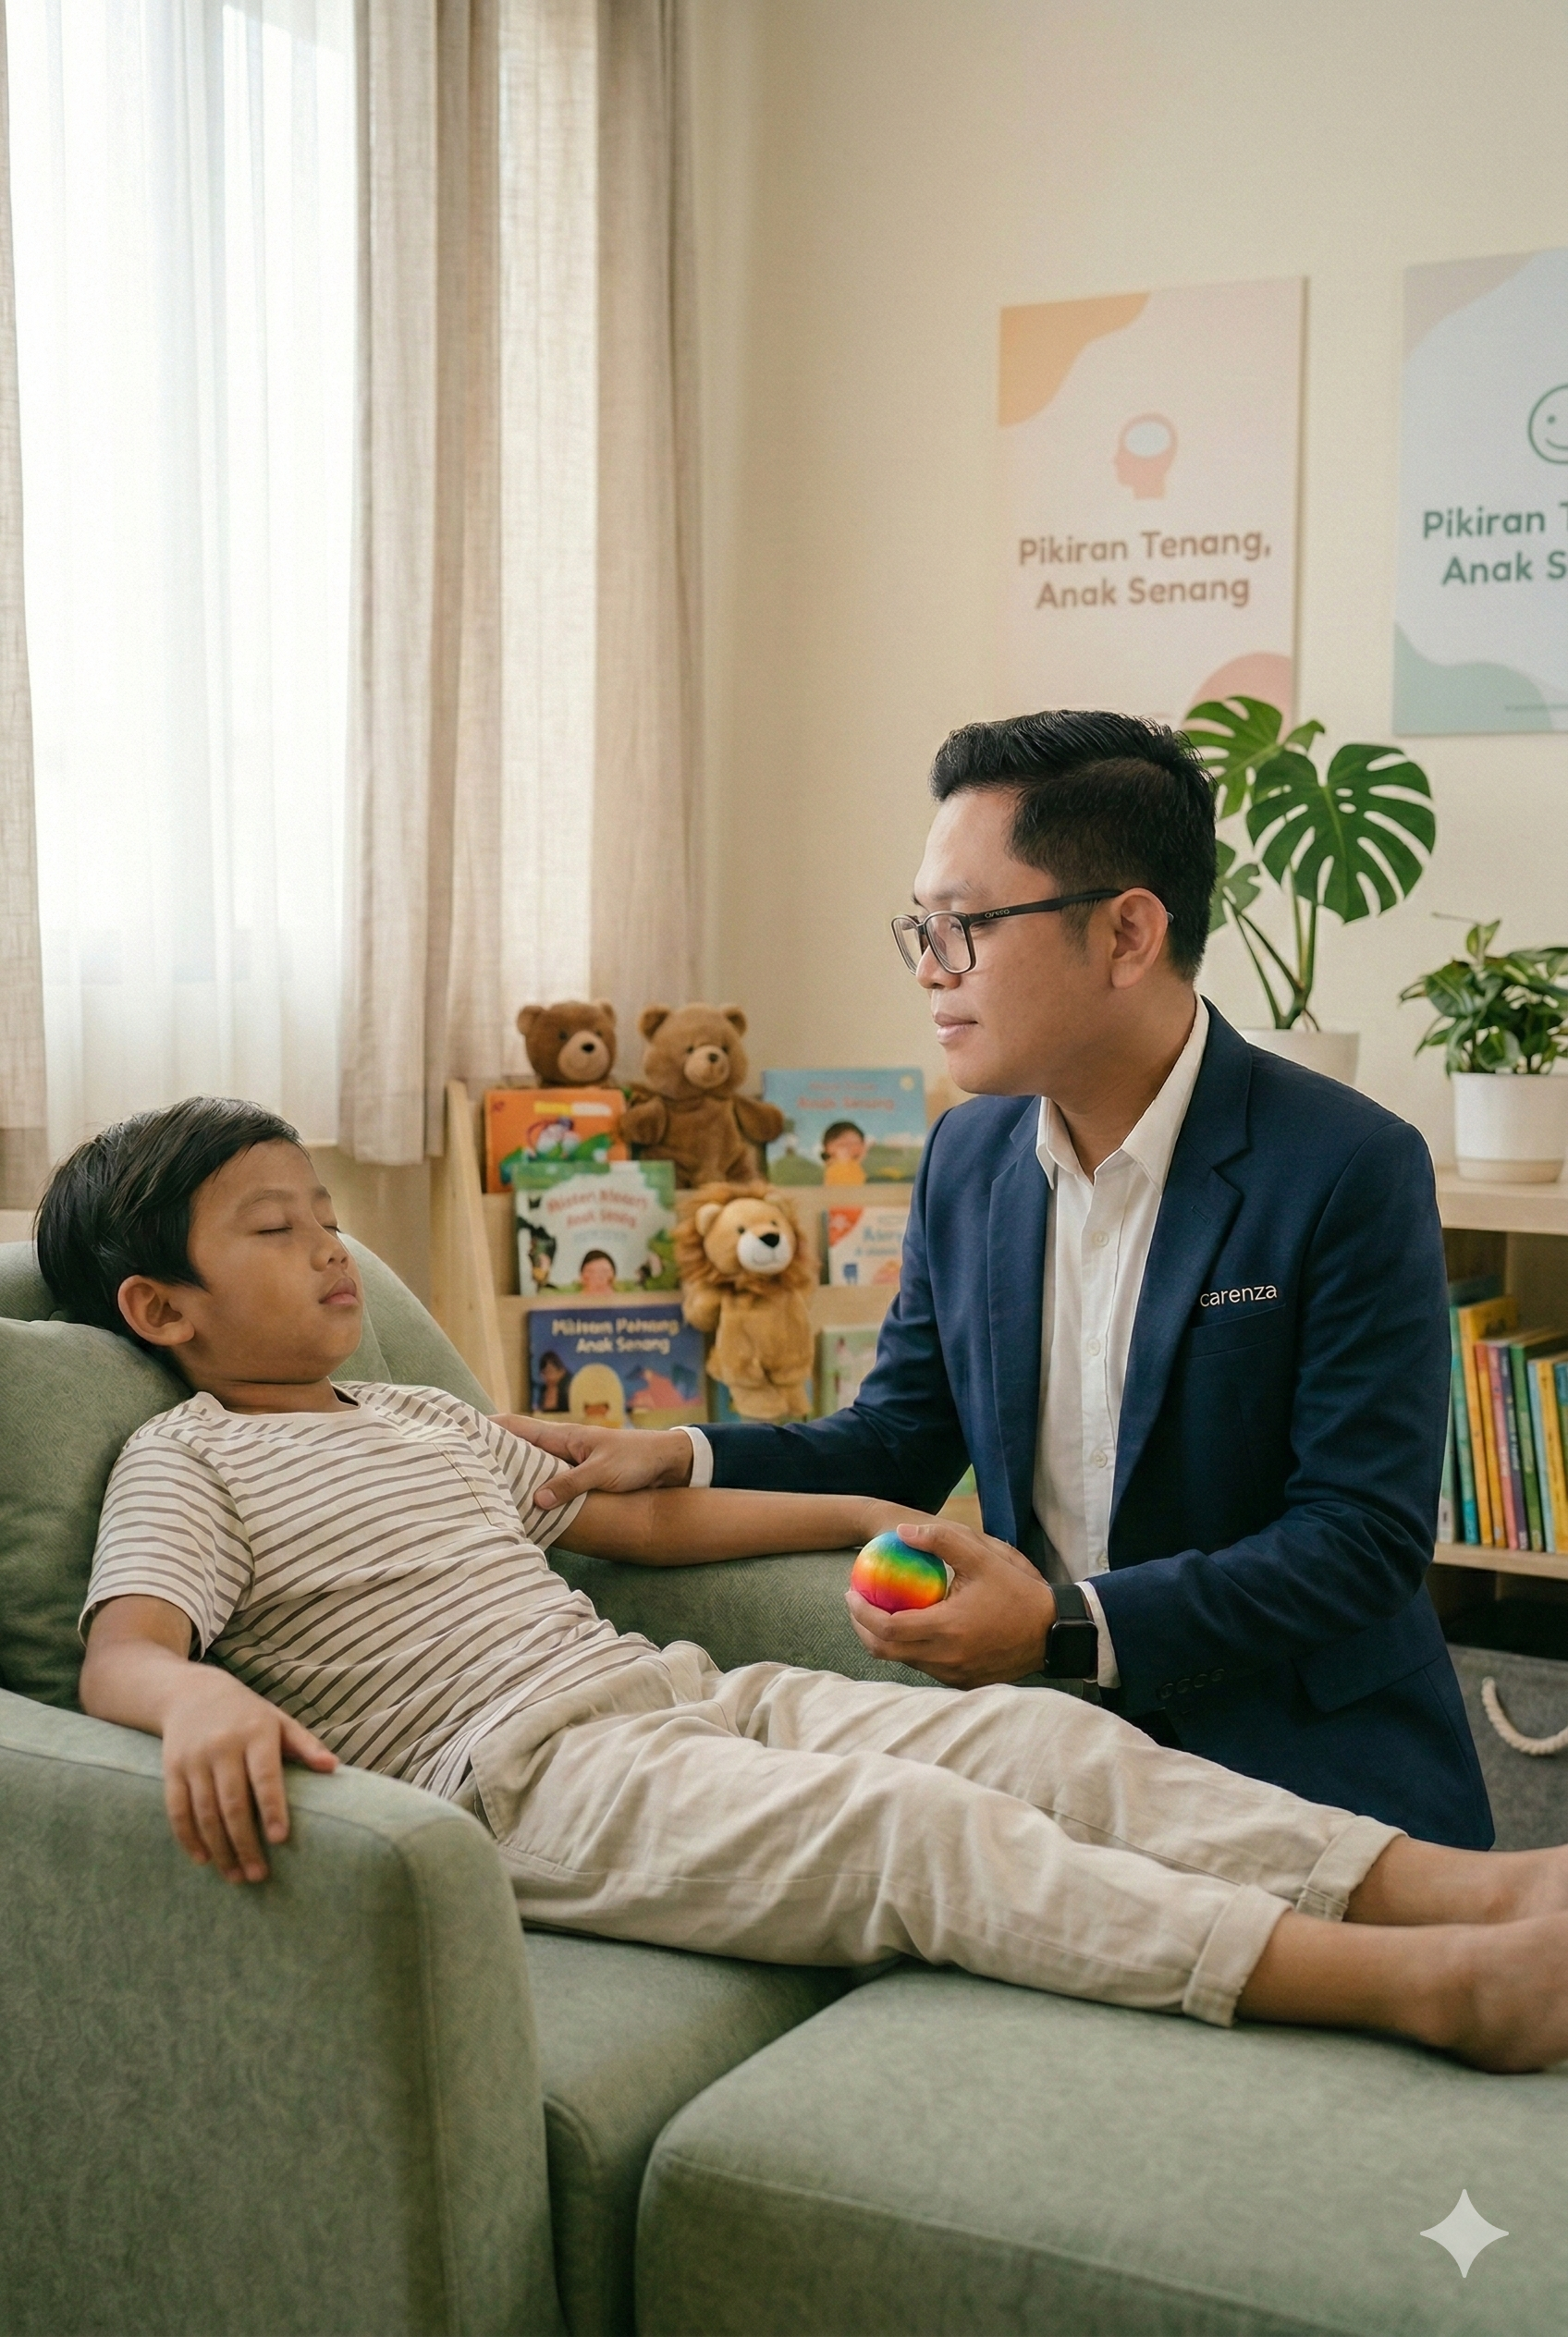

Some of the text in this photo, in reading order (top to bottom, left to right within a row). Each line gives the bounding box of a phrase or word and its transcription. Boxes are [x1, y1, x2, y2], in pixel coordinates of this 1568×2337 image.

[1424, 505, 1545, 539] Pikiran
[1019, 530, 1271, 566] Pikiran Tenang,
[1442, 550, 1533, 585] Anak
[1035, 576, 1250, 609] Anak Senang
[1200, 1284, 1278, 1307] carenza
